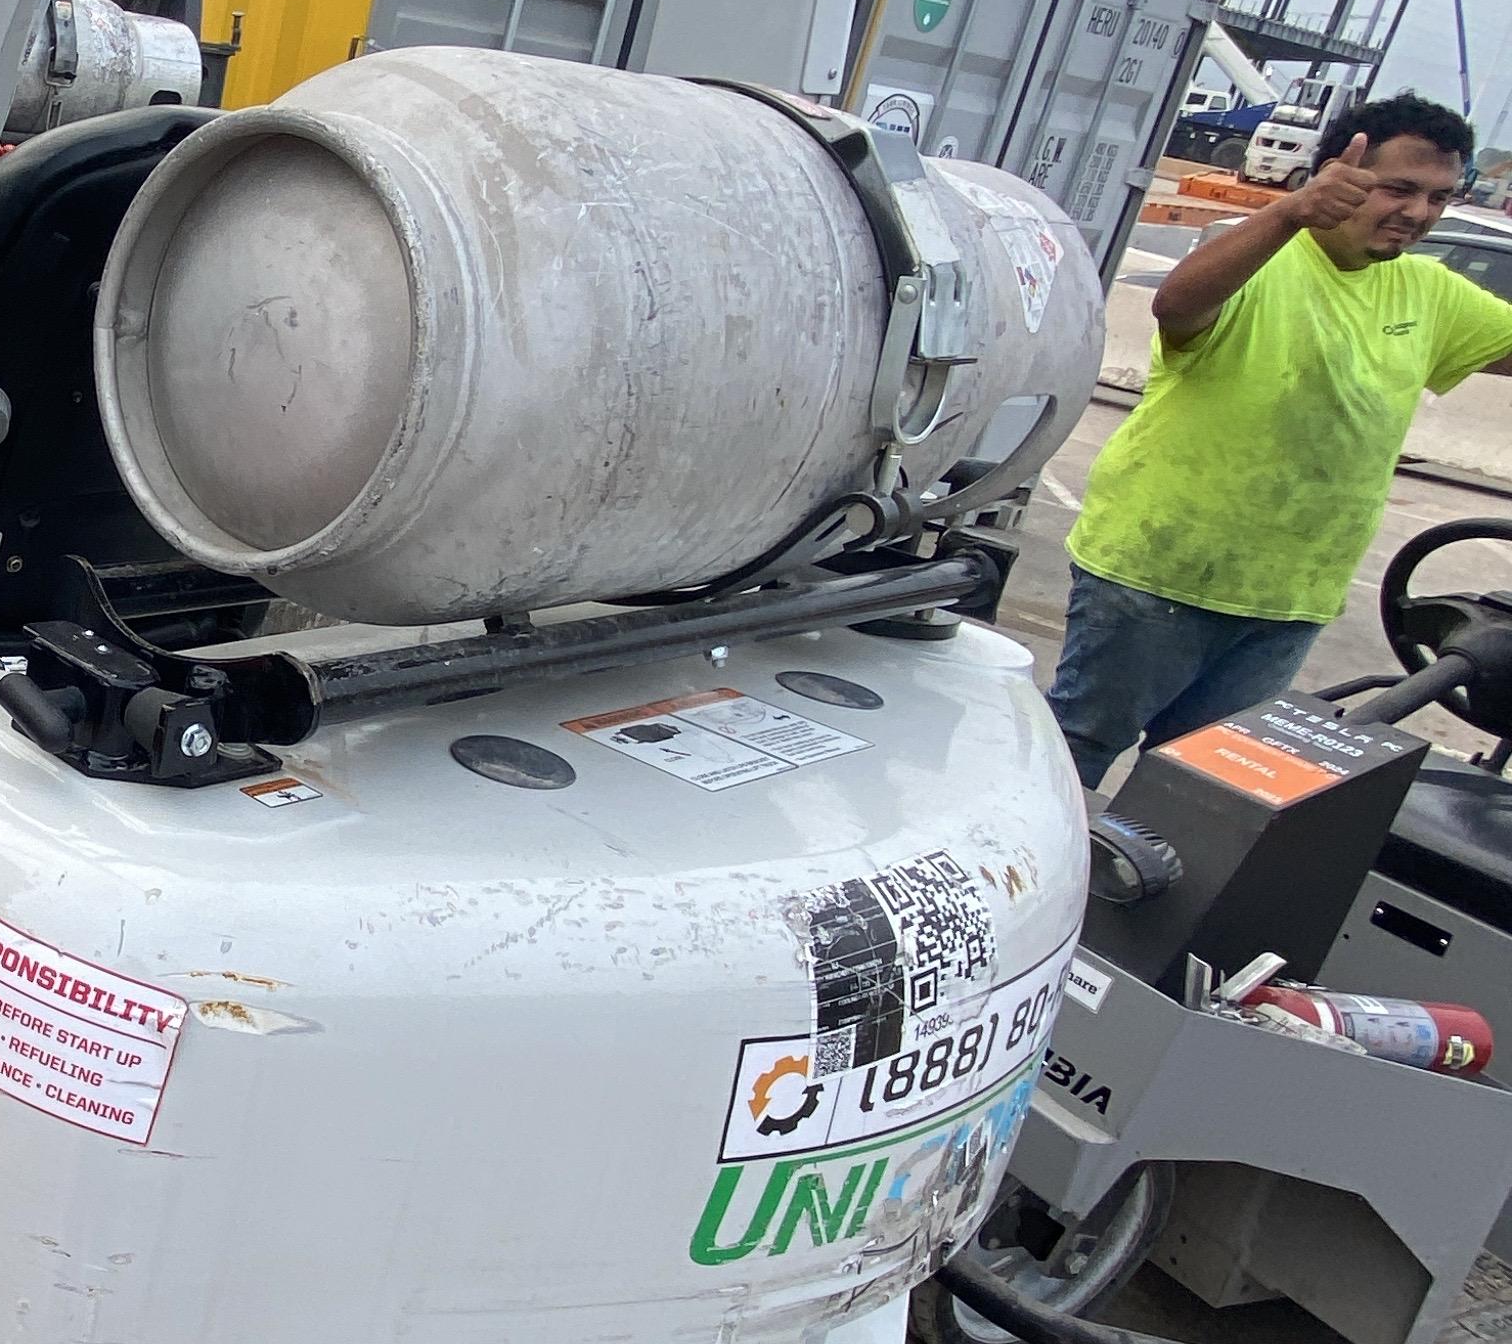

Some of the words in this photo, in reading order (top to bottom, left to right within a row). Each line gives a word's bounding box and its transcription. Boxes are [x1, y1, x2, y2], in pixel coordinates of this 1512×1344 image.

[1213, 747, 1278, 780] RENTAL
[8, 1035, 104, 1088] REFUELING
[55, 1029, 114, 1061] START
[115, 1049, 143, 1069] UP
[44, 1083, 136, 1126] CLEANING
